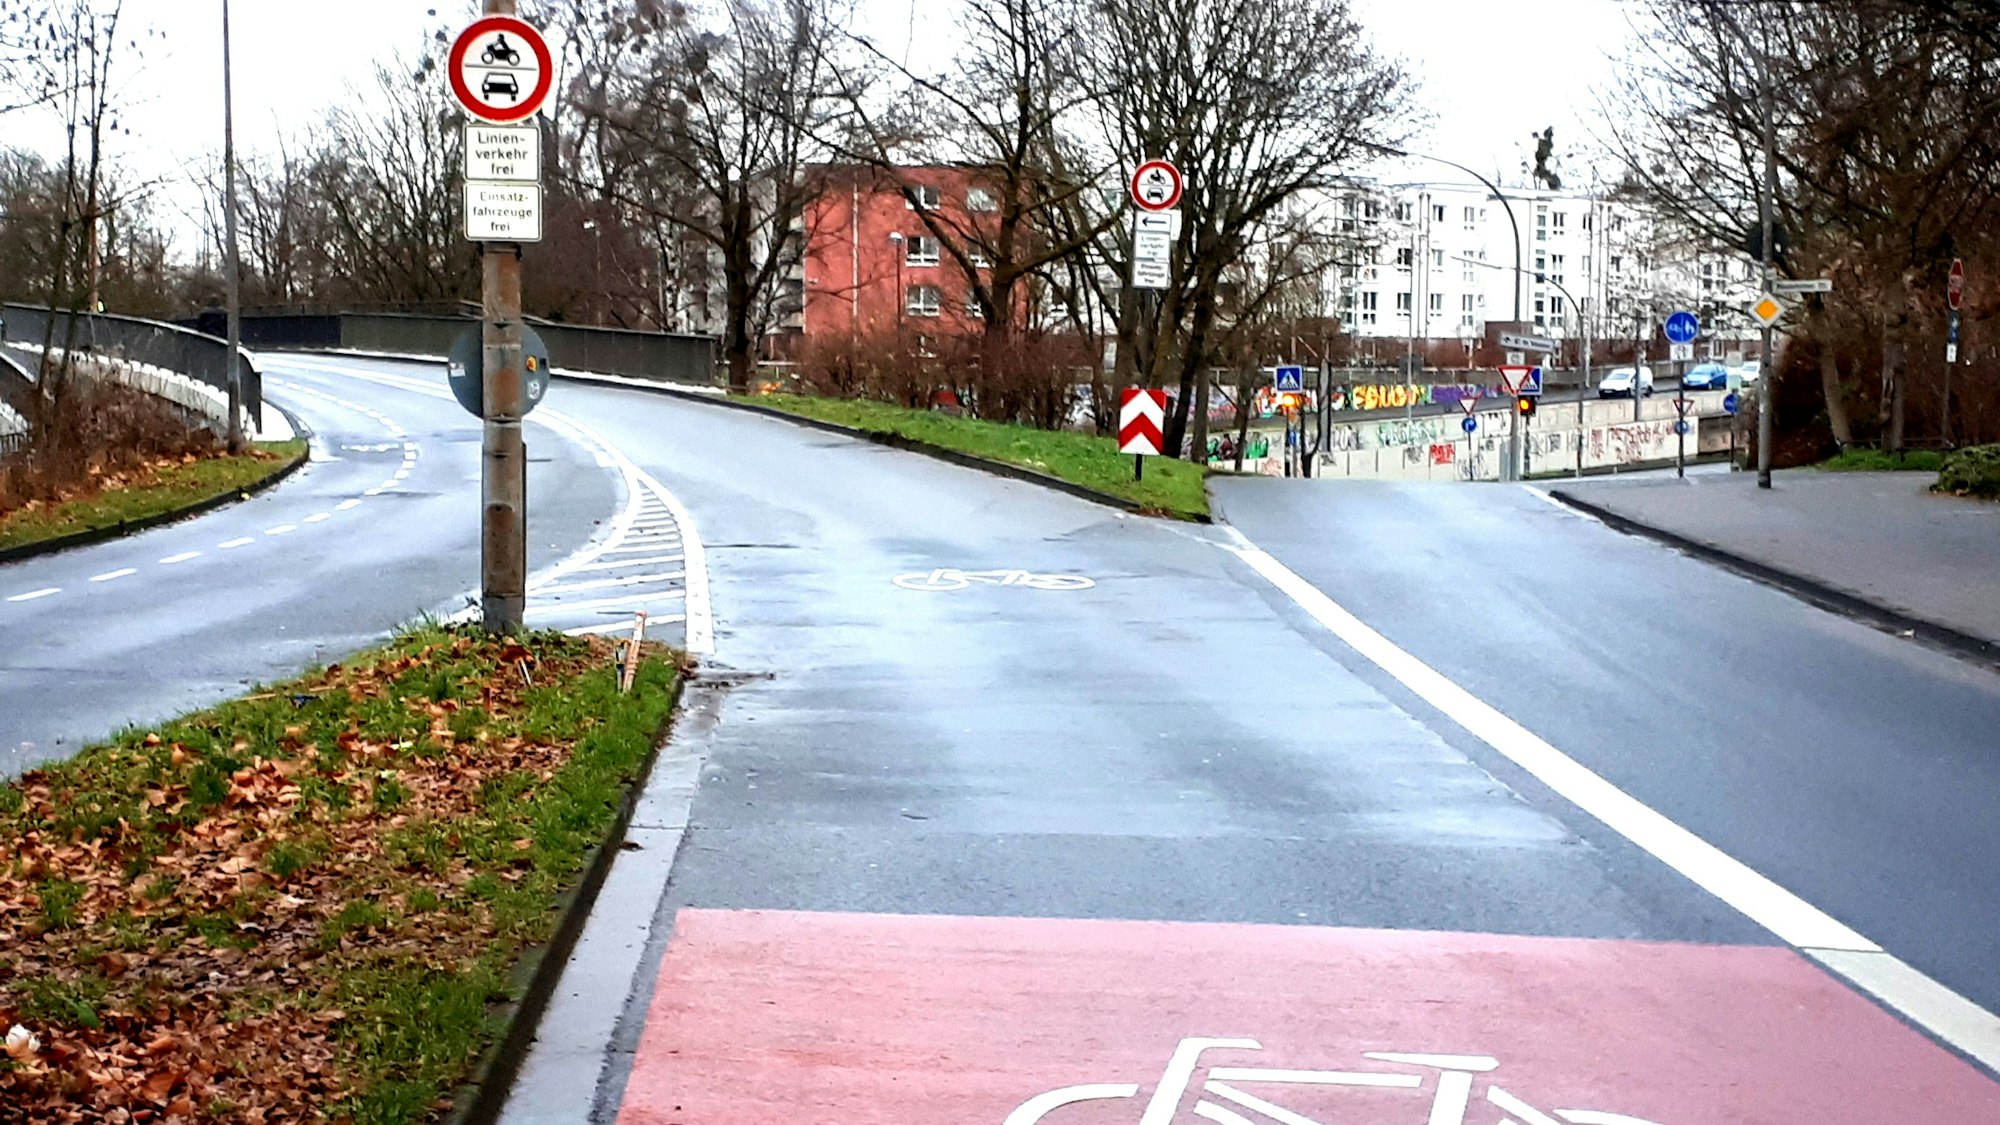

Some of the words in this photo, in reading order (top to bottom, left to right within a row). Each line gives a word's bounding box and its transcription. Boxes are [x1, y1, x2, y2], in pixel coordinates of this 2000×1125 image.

[477, 130, 526, 144] Linien-
[475, 147, 529, 160] verkehr
[491, 162, 514, 175] frei
[480, 191, 529, 202] Einsatz-
[473, 206, 533, 220] fahrzeuge
[490, 221, 511, 231] frei
